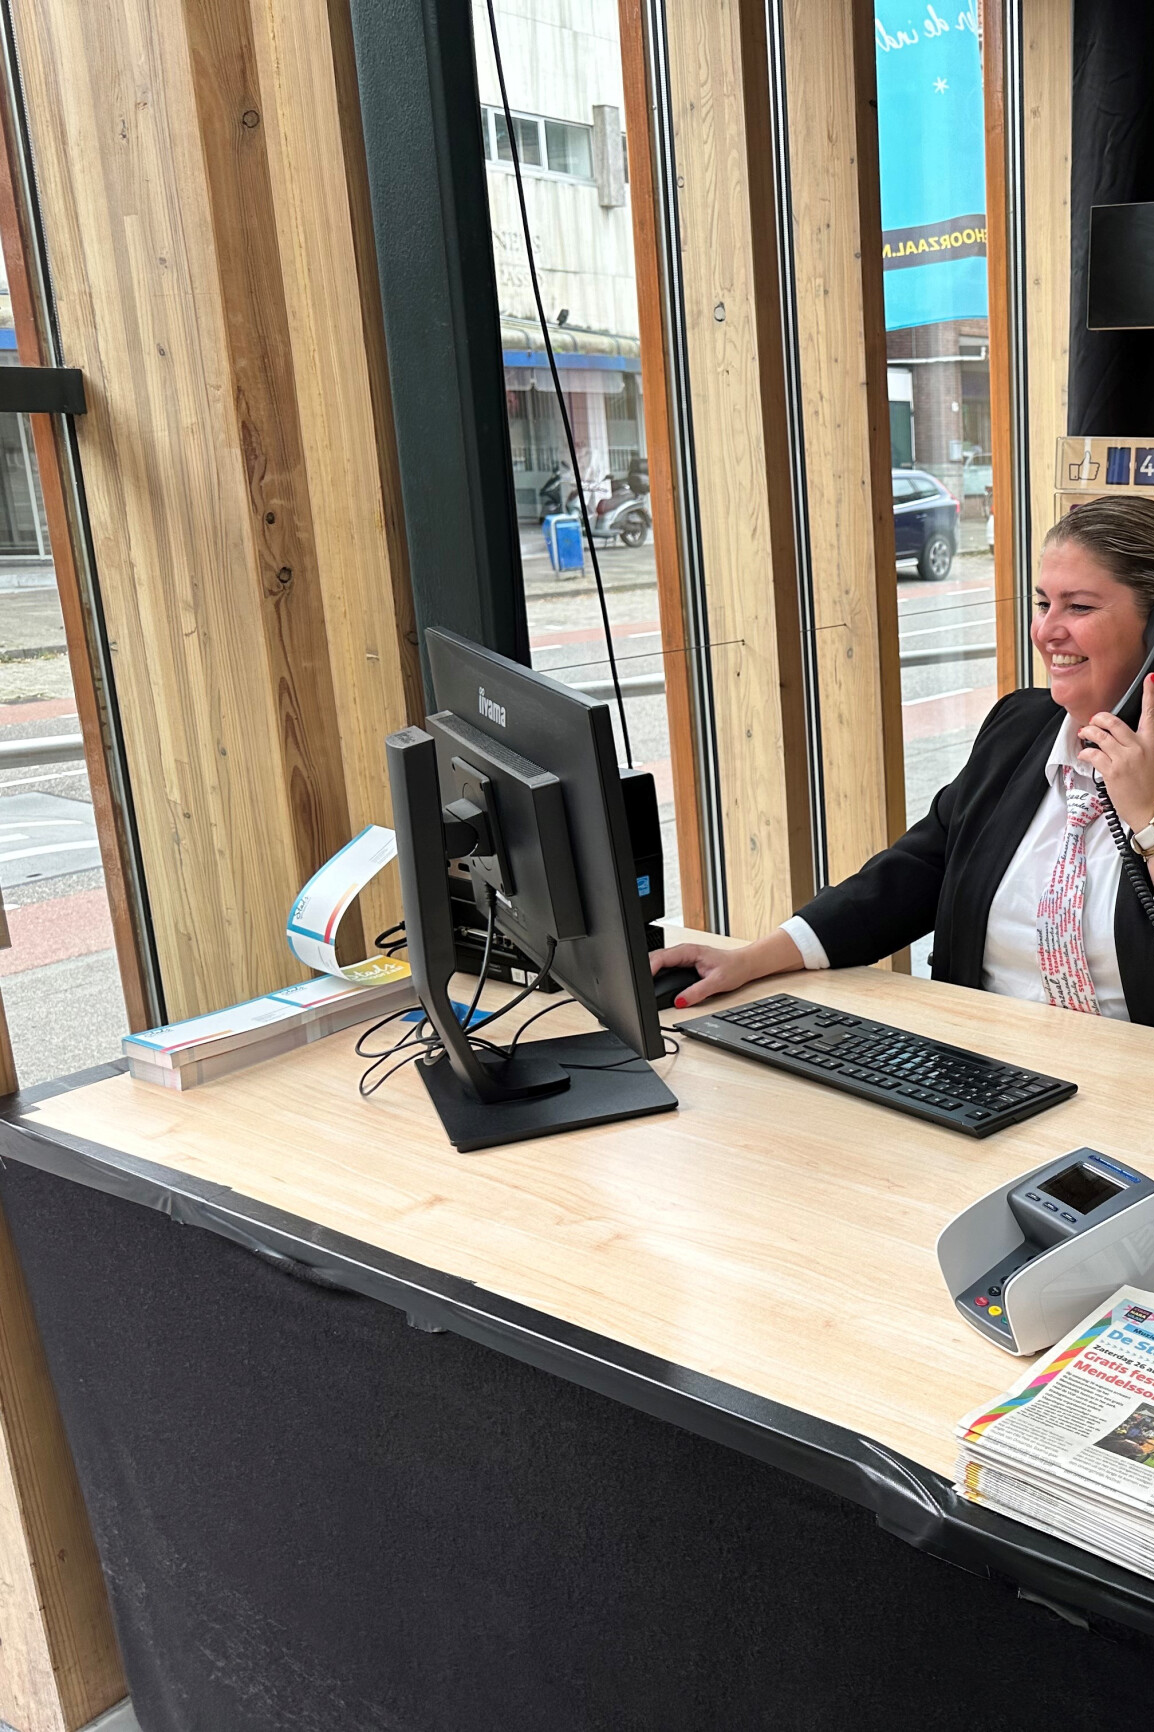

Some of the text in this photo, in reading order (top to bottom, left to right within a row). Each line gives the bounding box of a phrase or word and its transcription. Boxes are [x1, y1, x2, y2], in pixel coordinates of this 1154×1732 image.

[478, 686, 506, 728] iiyama
[1106, 1329, 1130, 1346] De
[1083, 1351, 1129, 1374] Gratis
[1093, 1344, 1134, 1366] Zaterdag
[1134, 1361, 1146, 1370] 26
